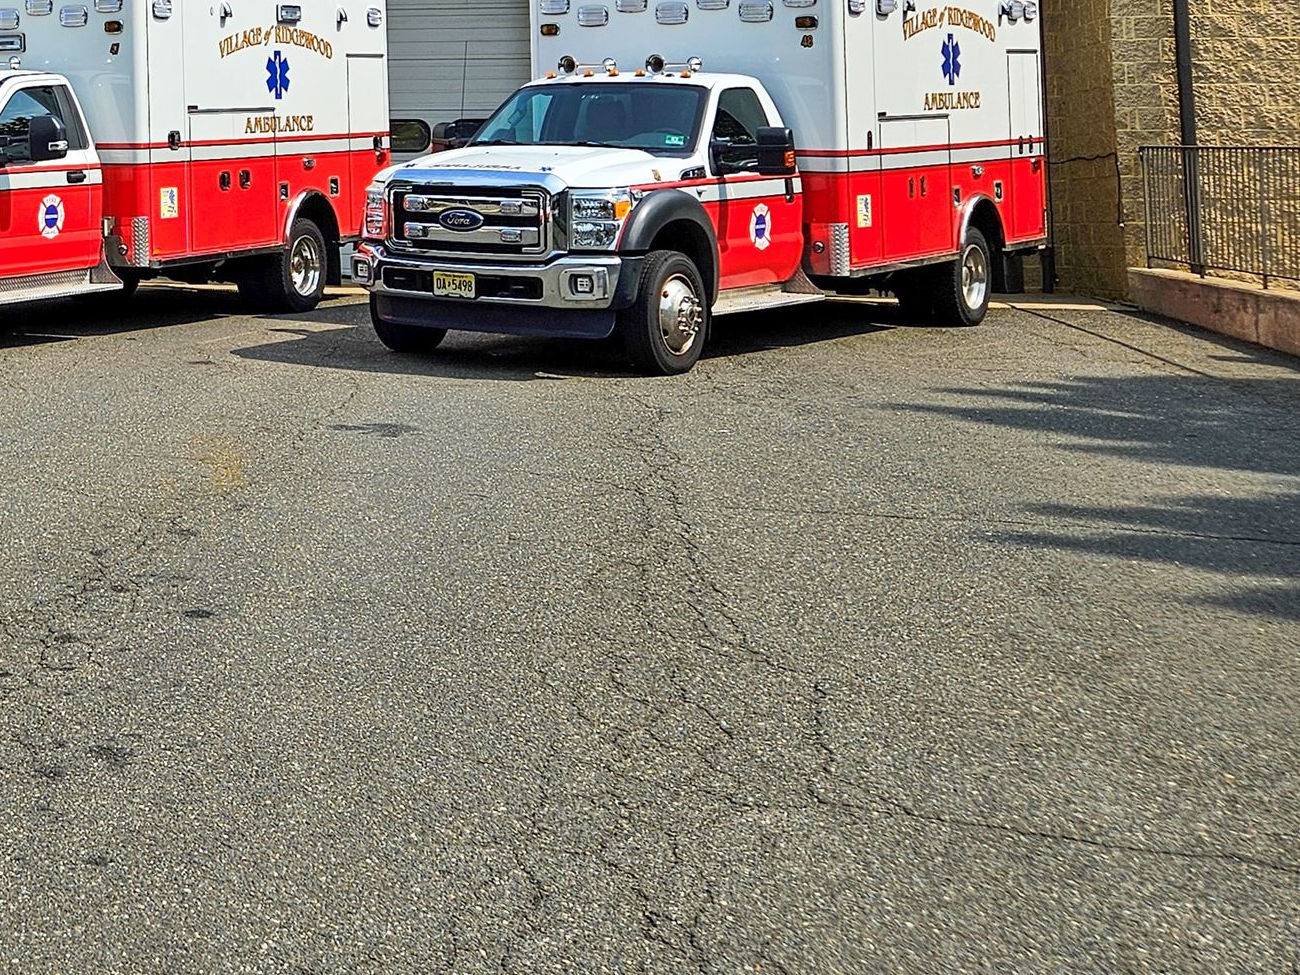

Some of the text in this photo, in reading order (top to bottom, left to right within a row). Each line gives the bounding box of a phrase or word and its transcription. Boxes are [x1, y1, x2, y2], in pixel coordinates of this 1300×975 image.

[903, 5, 996, 43] VILLAGE of RIDGEWOOD
[219, 25, 333, 59] VILLAGE of RIDGEWOOD
[923, 91, 981, 111] AMBULANCE
[245, 115, 314, 134] AMBULANCE
[447, 212, 472, 226] Ford
